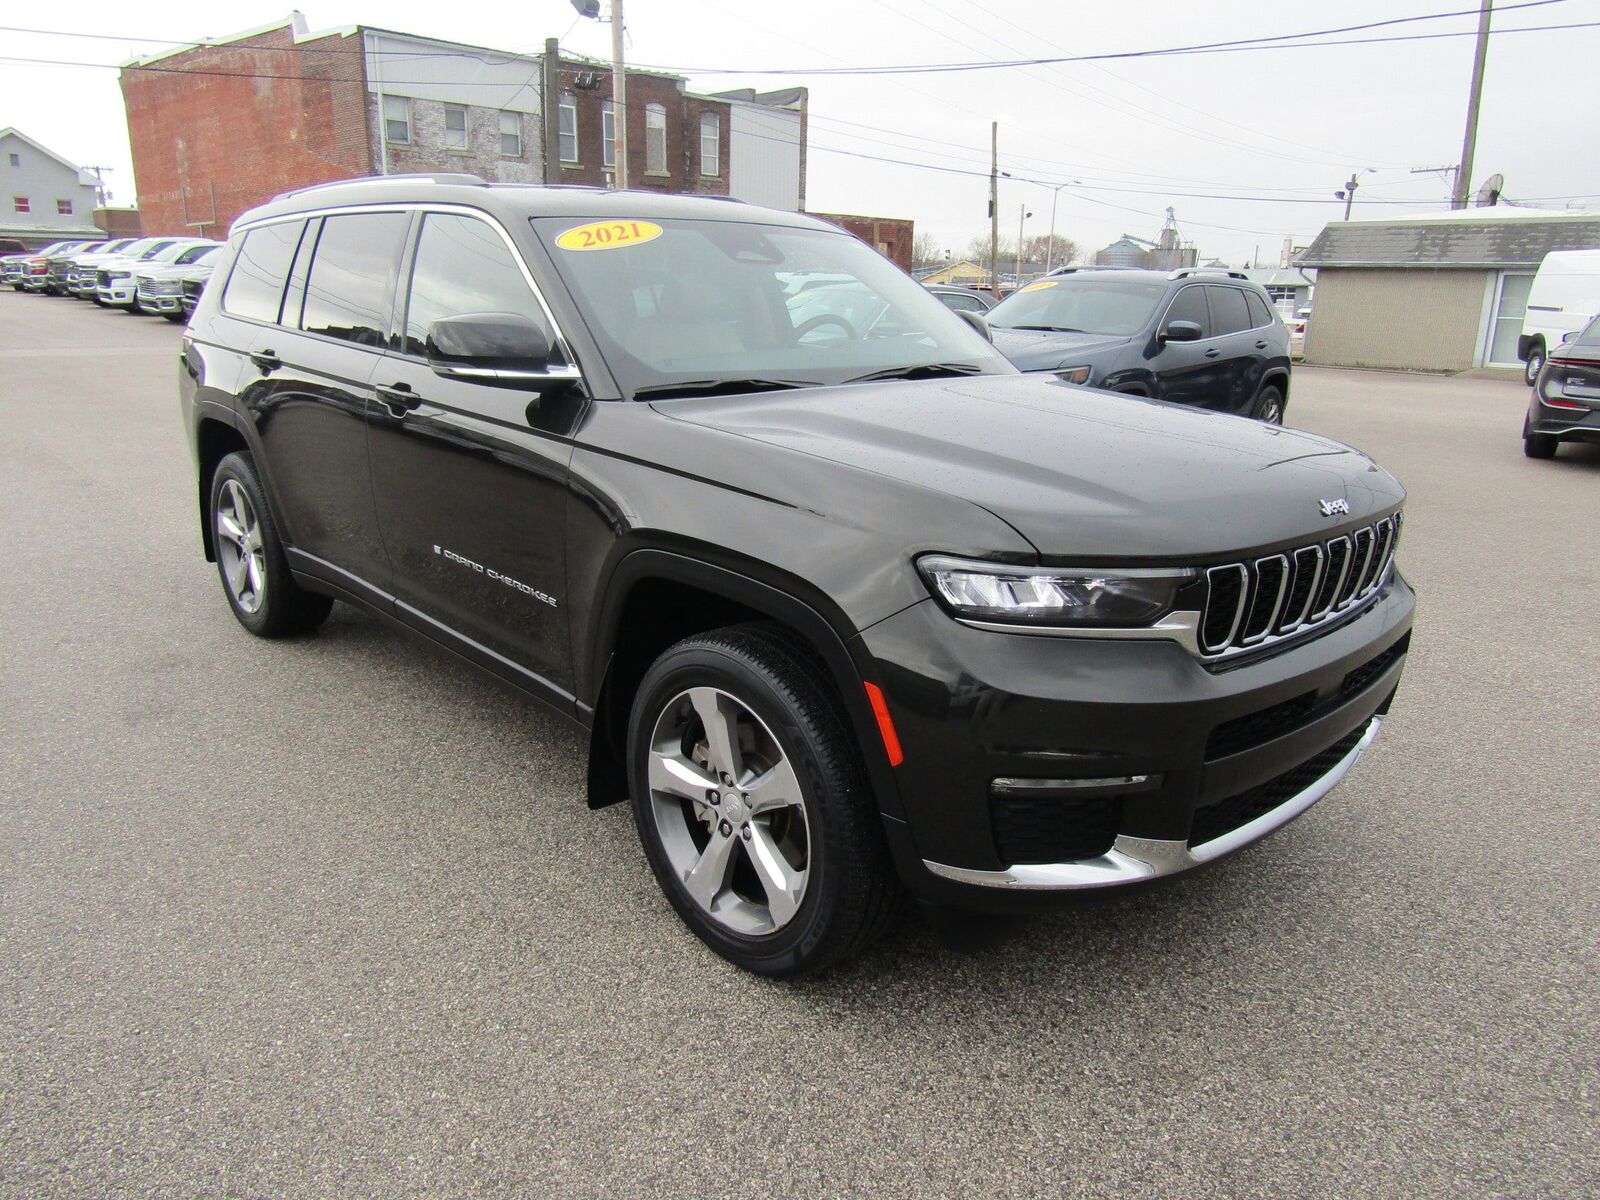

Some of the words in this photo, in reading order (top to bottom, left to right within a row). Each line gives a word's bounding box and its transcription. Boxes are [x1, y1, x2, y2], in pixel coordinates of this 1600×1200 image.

[579, 223, 641, 247] 2021
[1320, 499, 1349, 515] Jeep
[444, 549, 484, 573] GRAND
[487, 568, 558, 608] CHEROKEE
